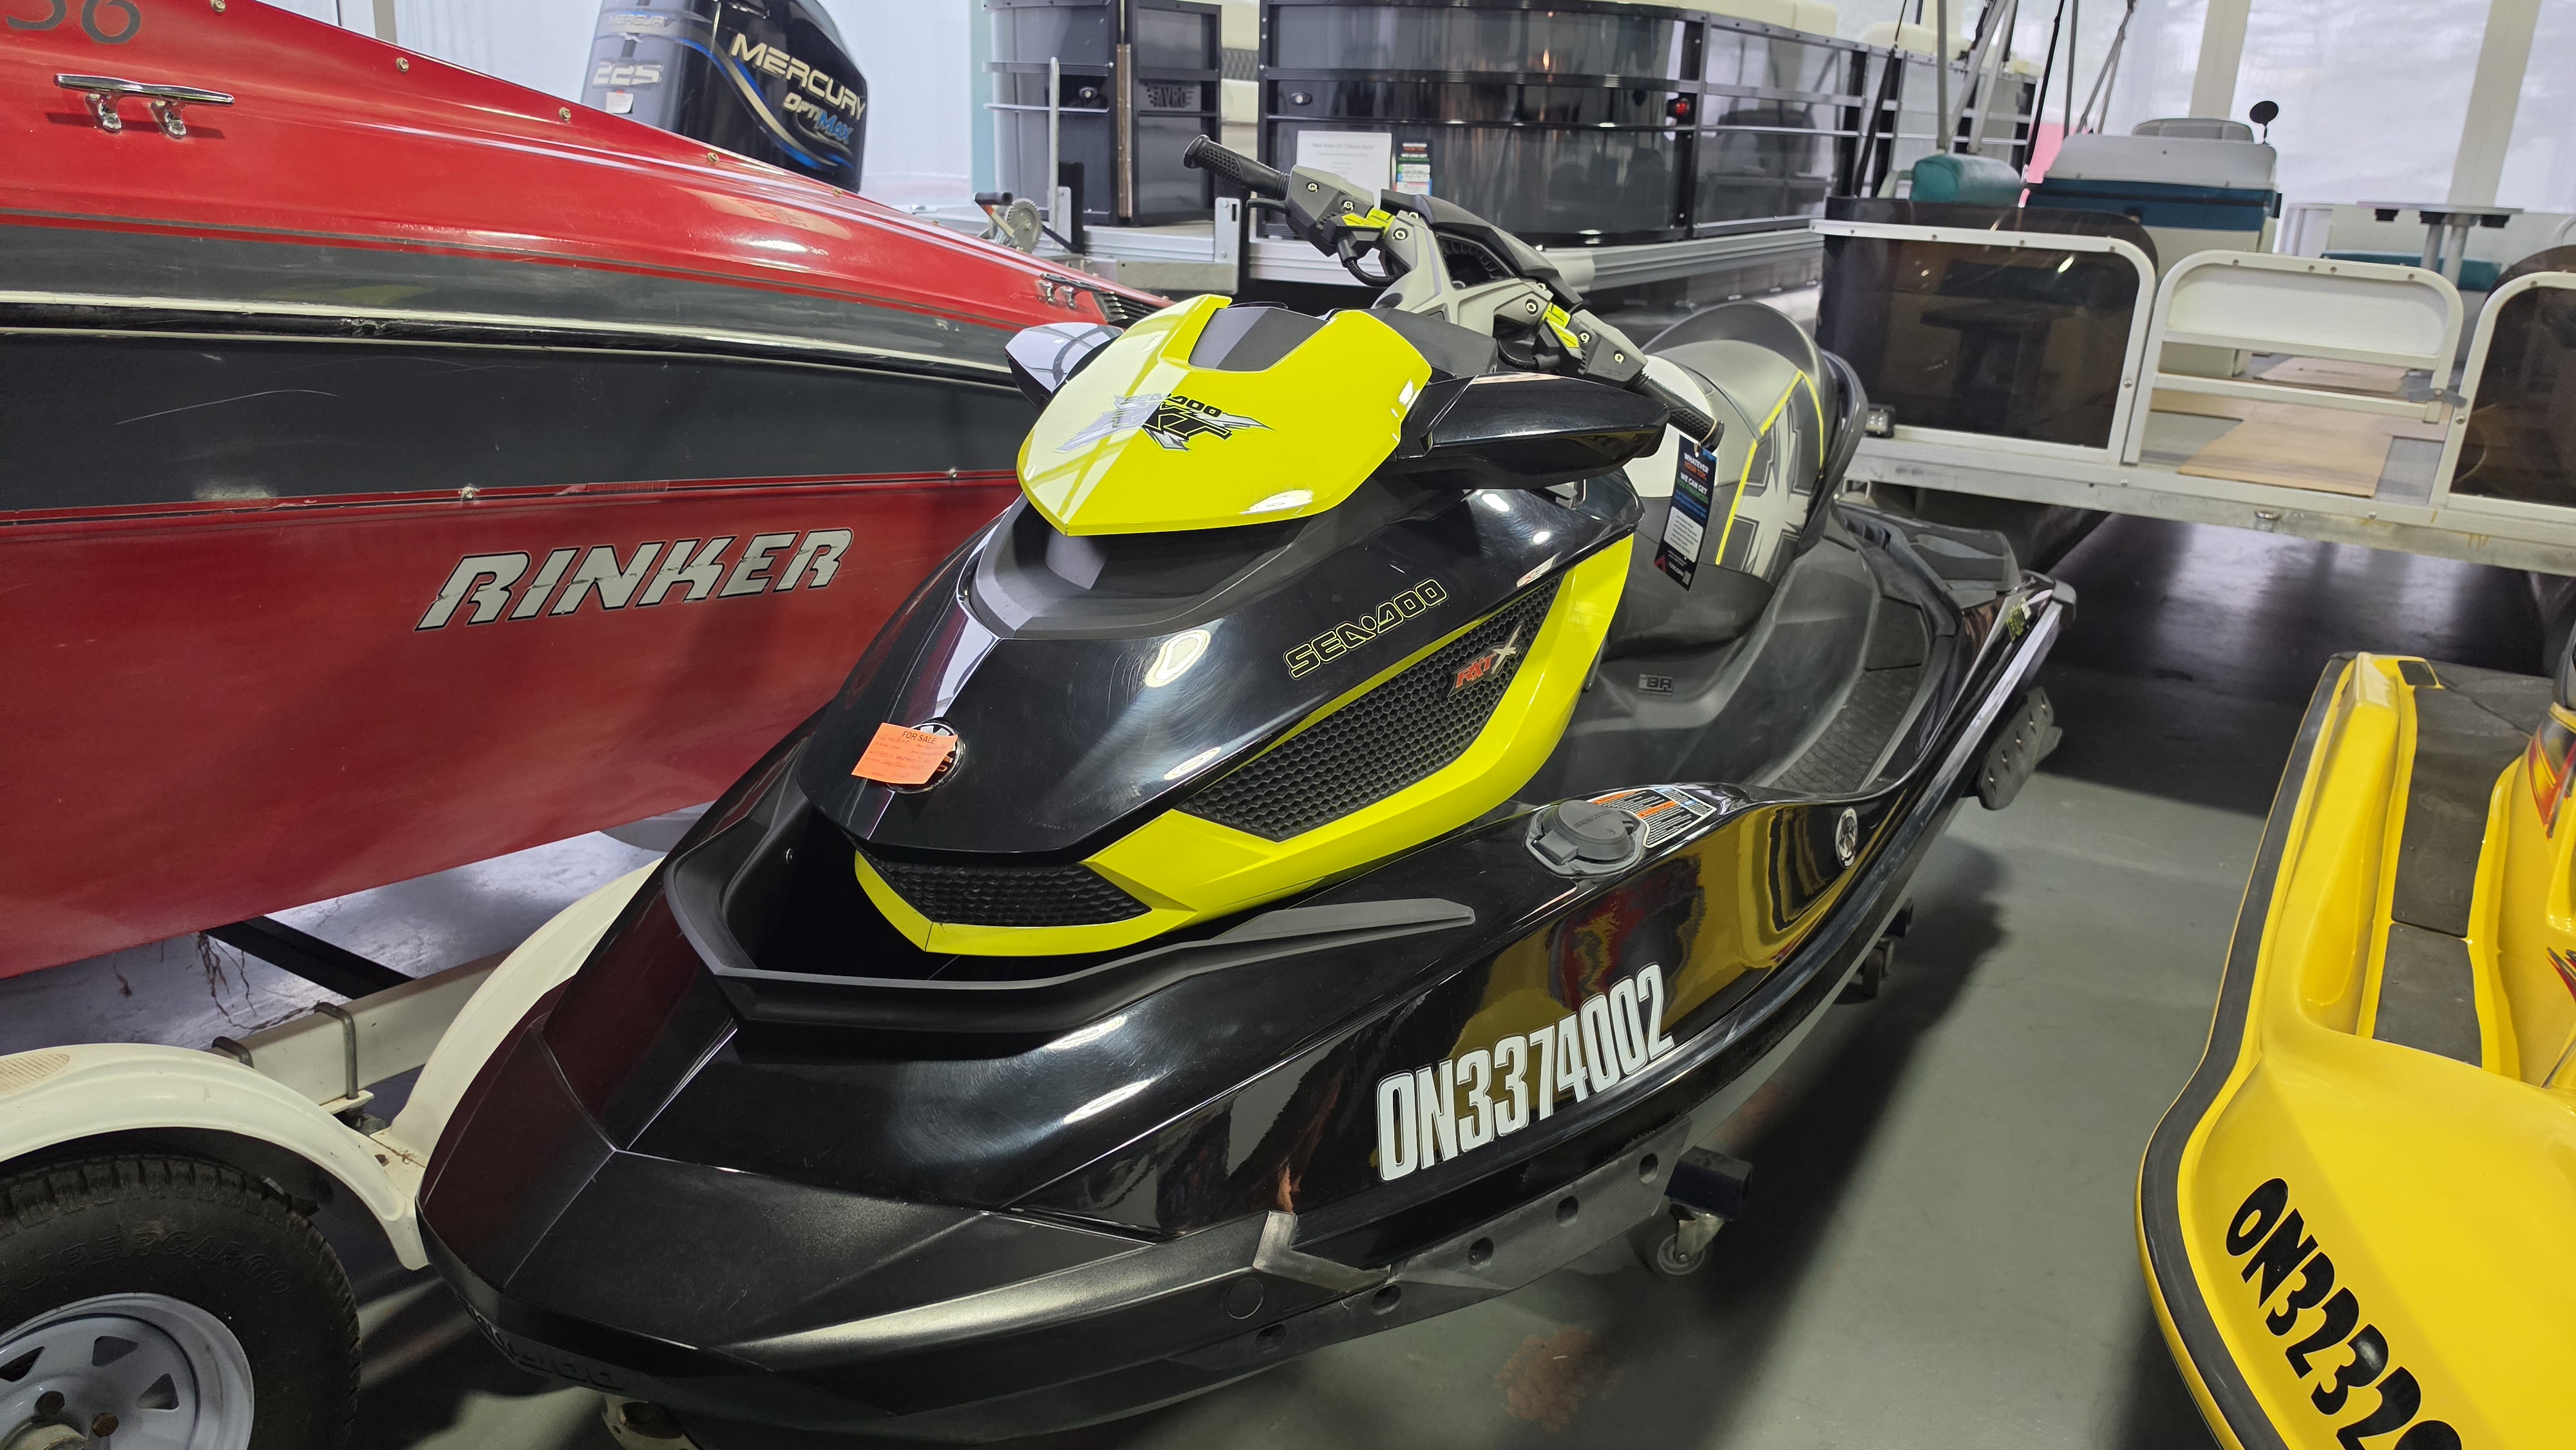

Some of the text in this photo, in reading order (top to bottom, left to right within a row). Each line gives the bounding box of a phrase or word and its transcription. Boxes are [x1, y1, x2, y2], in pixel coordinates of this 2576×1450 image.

[608, 14, 675, 28] MERCURY
[592, 61, 663, 86] 225
[730, 32, 867, 121] MERCURY
[1683, 452, 1709, 474] WHATEVER
[1680, 472, 1708, 495] WE CAN GET
[414, 528, 853, 632] RINKER
[901, 731, 918, 740] FOR
[919, 734, 938, 744] SALE
[1376, 962, 1676, 1182] ON3374002
